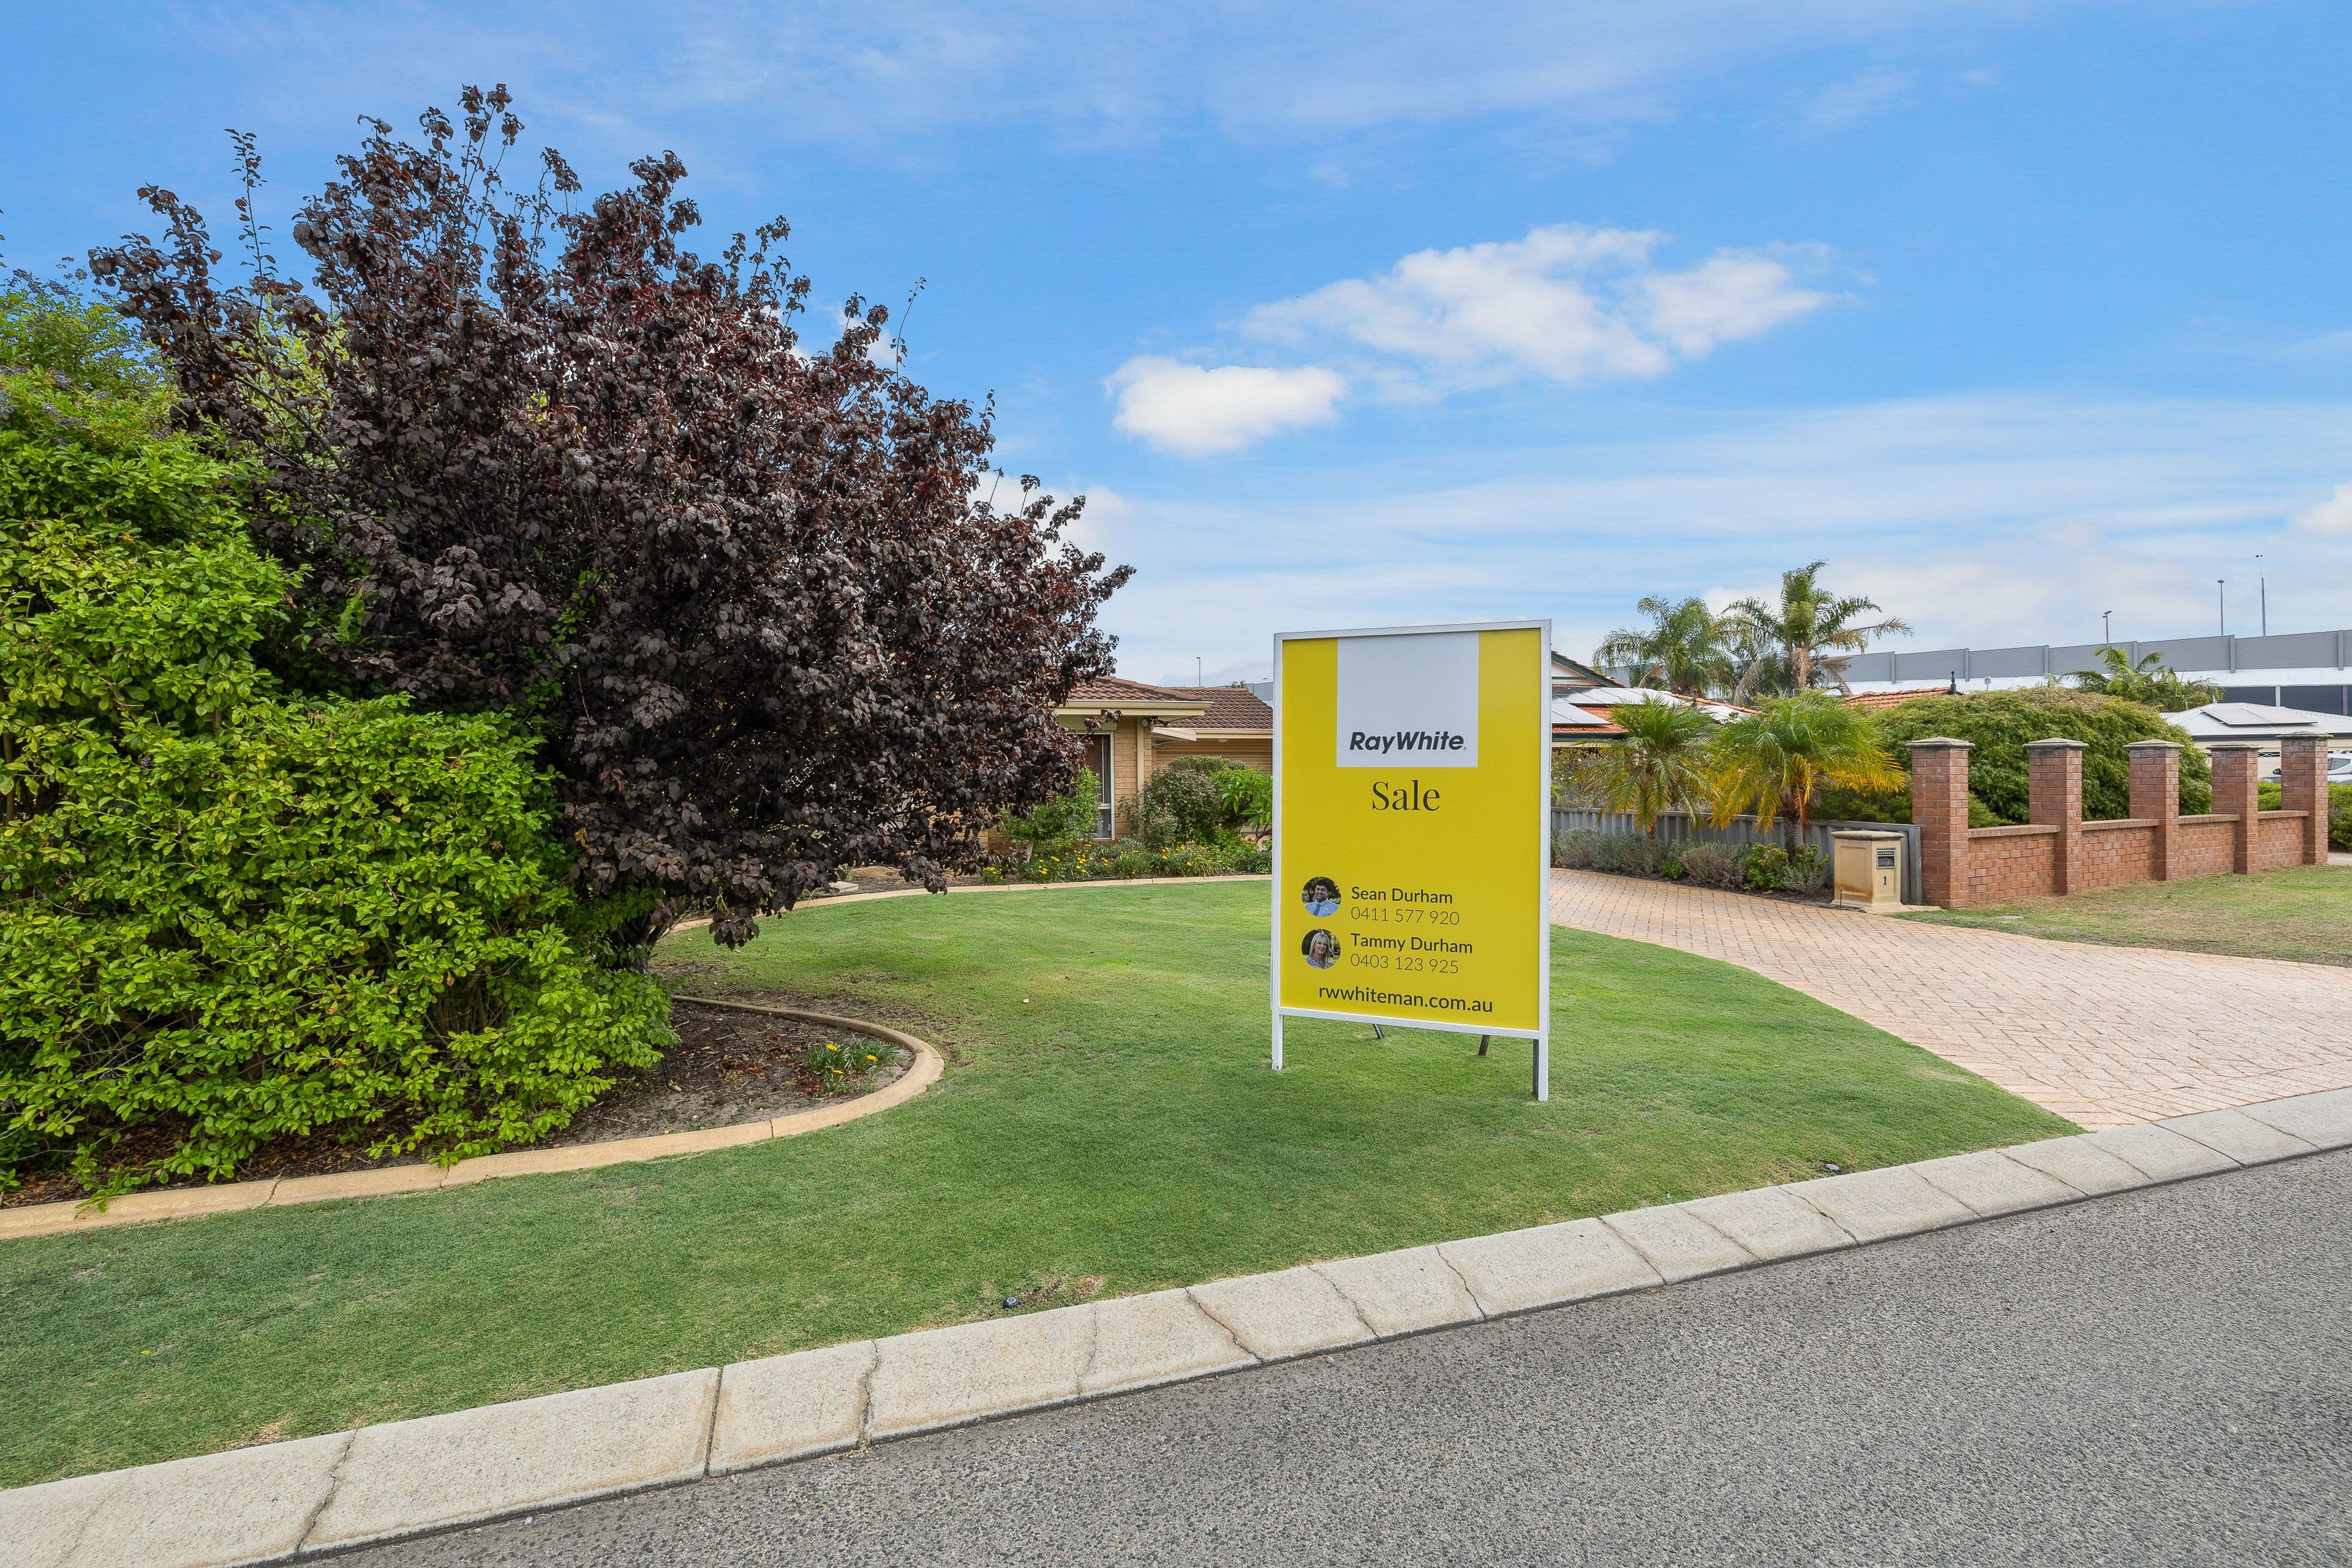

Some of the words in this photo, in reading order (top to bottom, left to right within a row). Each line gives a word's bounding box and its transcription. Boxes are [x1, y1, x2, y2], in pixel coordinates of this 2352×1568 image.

[1372, 779, 1440, 812] Sale
[1883, 876, 1887, 886] 1
[1351, 886, 1387, 901] Sean
[1392, 888, 1453, 904] Durham
[1351, 907, 1389, 922] 0411
[1395, 908, 1424, 923] 577
[1430, 910, 1460, 925] 920
[1351, 933, 1406, 952] Tammy
[1411, 937, 1473, 954] Durham
[1351, 953, 1389, 969] 0403
[1395, 956, 1423, 971] 123
[1429, 959, 1458, 974] 925
[1319, 986, 1493, 1013] rwwhiteman.com.au
